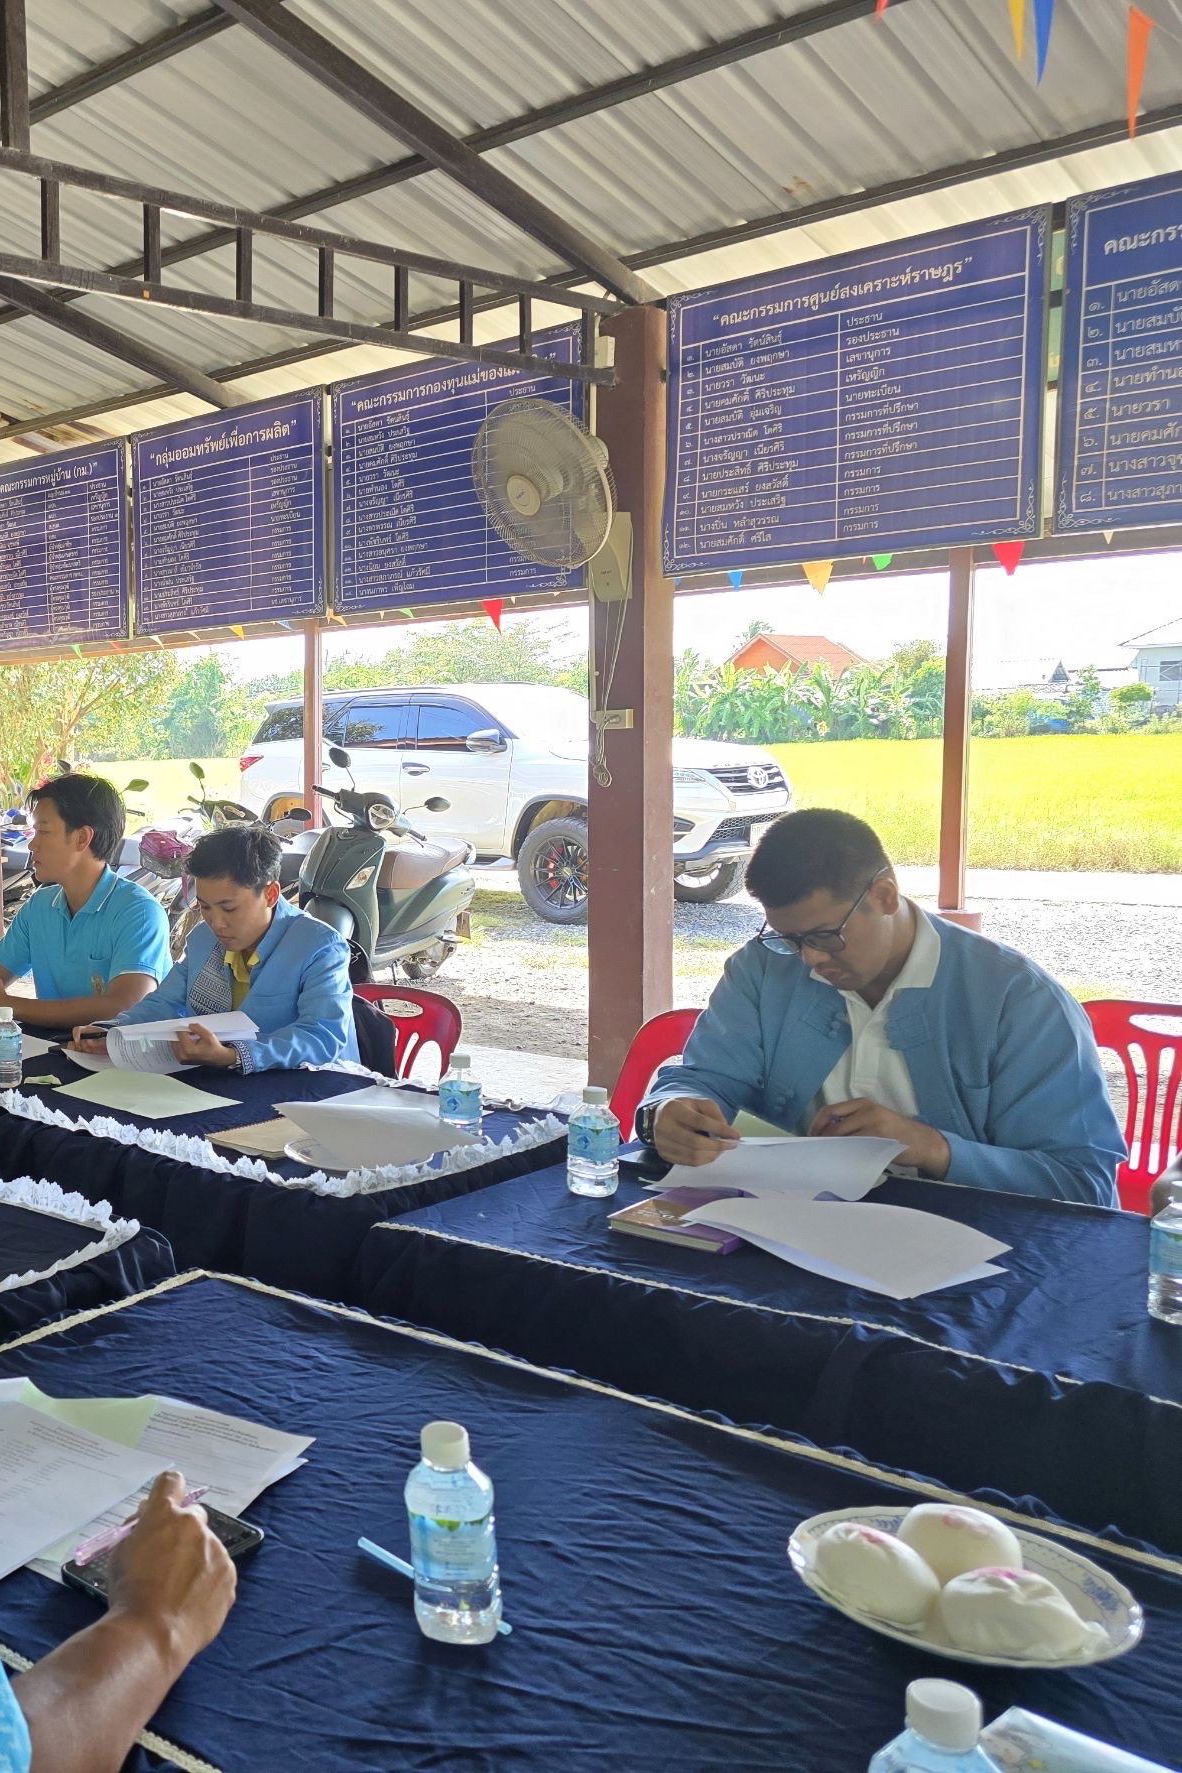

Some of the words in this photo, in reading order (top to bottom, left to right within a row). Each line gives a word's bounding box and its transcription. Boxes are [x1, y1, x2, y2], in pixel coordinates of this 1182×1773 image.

[846, 311, 883, 328] ประธาน
[846, 326, 900, 345] รองประธาน
[846, 346, 891, 364] เลขานุการ
[845, 366, 885, 383] เหรัญญิก
[845, 384, 901, 402] นายทะเบียน
[845, 400, 918, 422] กรรมการที่ปรึกษา
[845, 420, 918, 441] กรรมการที่ปรึกษา
[844, 440, 918, 461] กรรมการที่ปรึกษา
[844, 465, 882, 479] กรรมการ
[843, 483, 881, 497] กรรมการ
[843, 502, 880, 515] กรรมการ
[843, 520, 879, 533] กรรมการ
